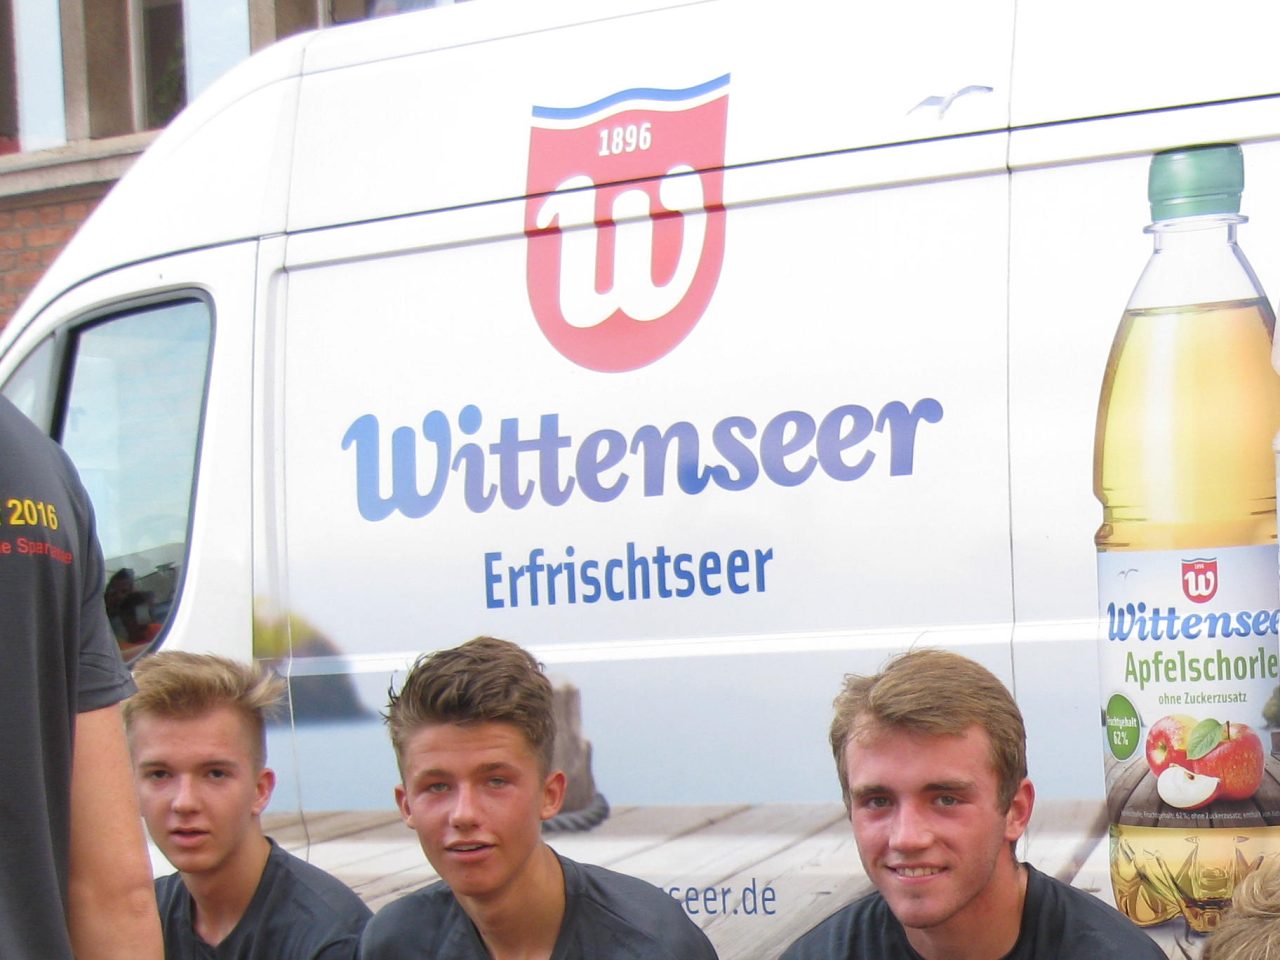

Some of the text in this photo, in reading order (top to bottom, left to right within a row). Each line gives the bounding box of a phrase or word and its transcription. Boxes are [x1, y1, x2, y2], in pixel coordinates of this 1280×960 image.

[598, 122, 652, 156] 1896
[341, 397, 944, 522] Wittenseer
[7, 498, 59, 530] 2016
[484, 541, 774, 610] Erfrischtseer
[1124, 646, 1279, 691] Apfelschorle
[1158, 691, 1248, 706] ohne Zuckerzusatz
